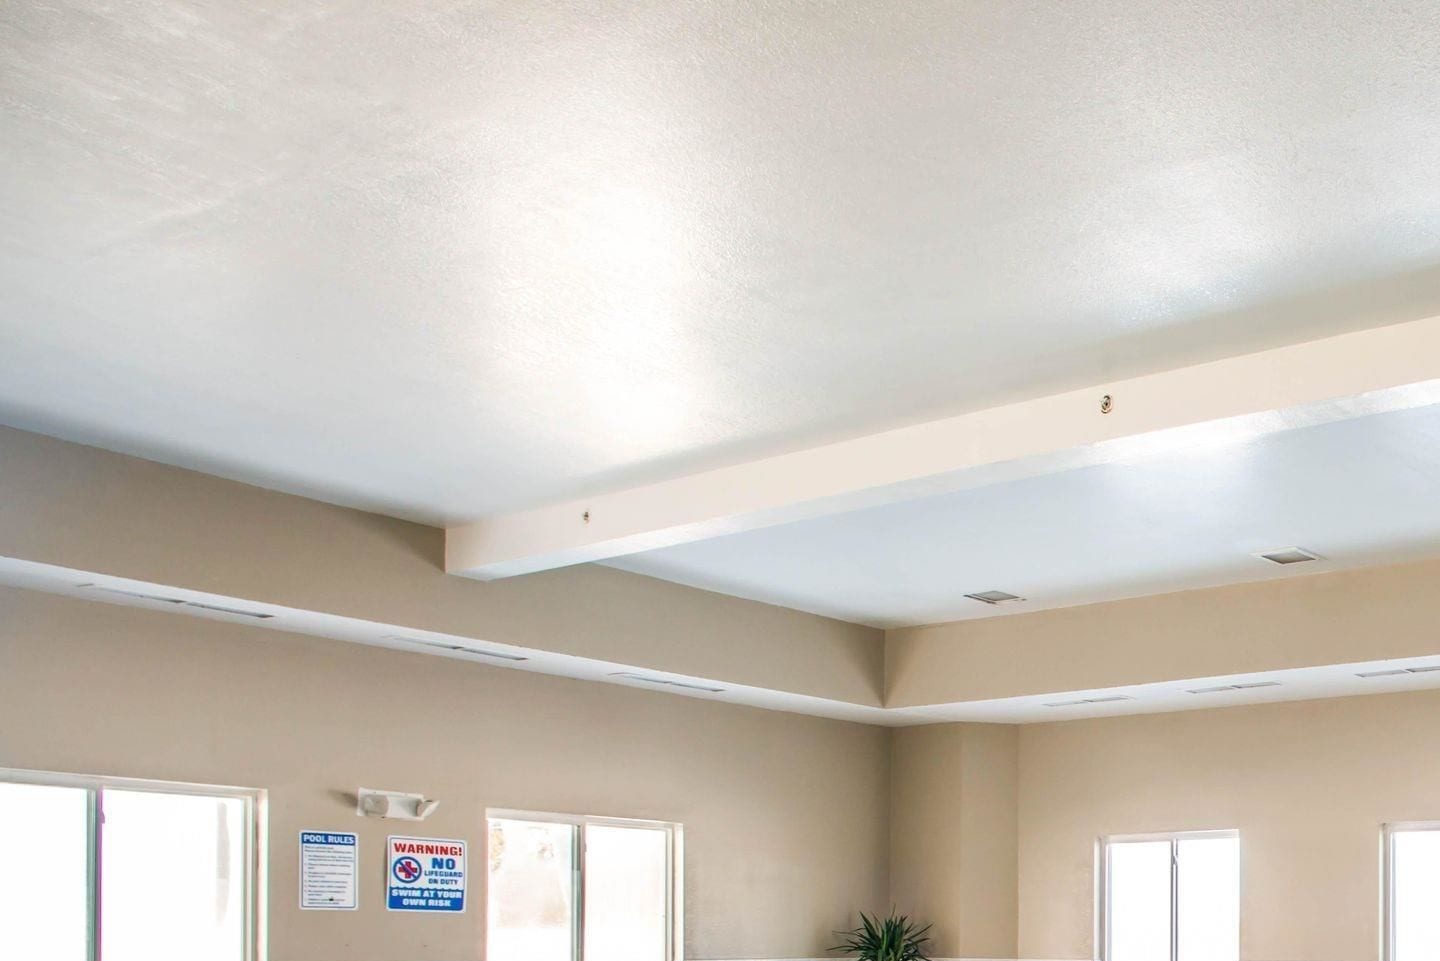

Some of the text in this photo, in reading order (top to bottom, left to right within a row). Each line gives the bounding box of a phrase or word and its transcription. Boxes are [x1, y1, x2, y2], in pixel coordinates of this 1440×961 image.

[303, 834, 354, 845] POOL RULES
[394, 843, 463, 857] WARNING!
[432, 857, 456, 870] NO
[423, 870, 464, 878] LIFEGUARD
[440, 878, 459, 886] DUTY
[391, 888, 463, 899] SWIM AT YOUR
[402, 897, 452, 907] OWN RISK
